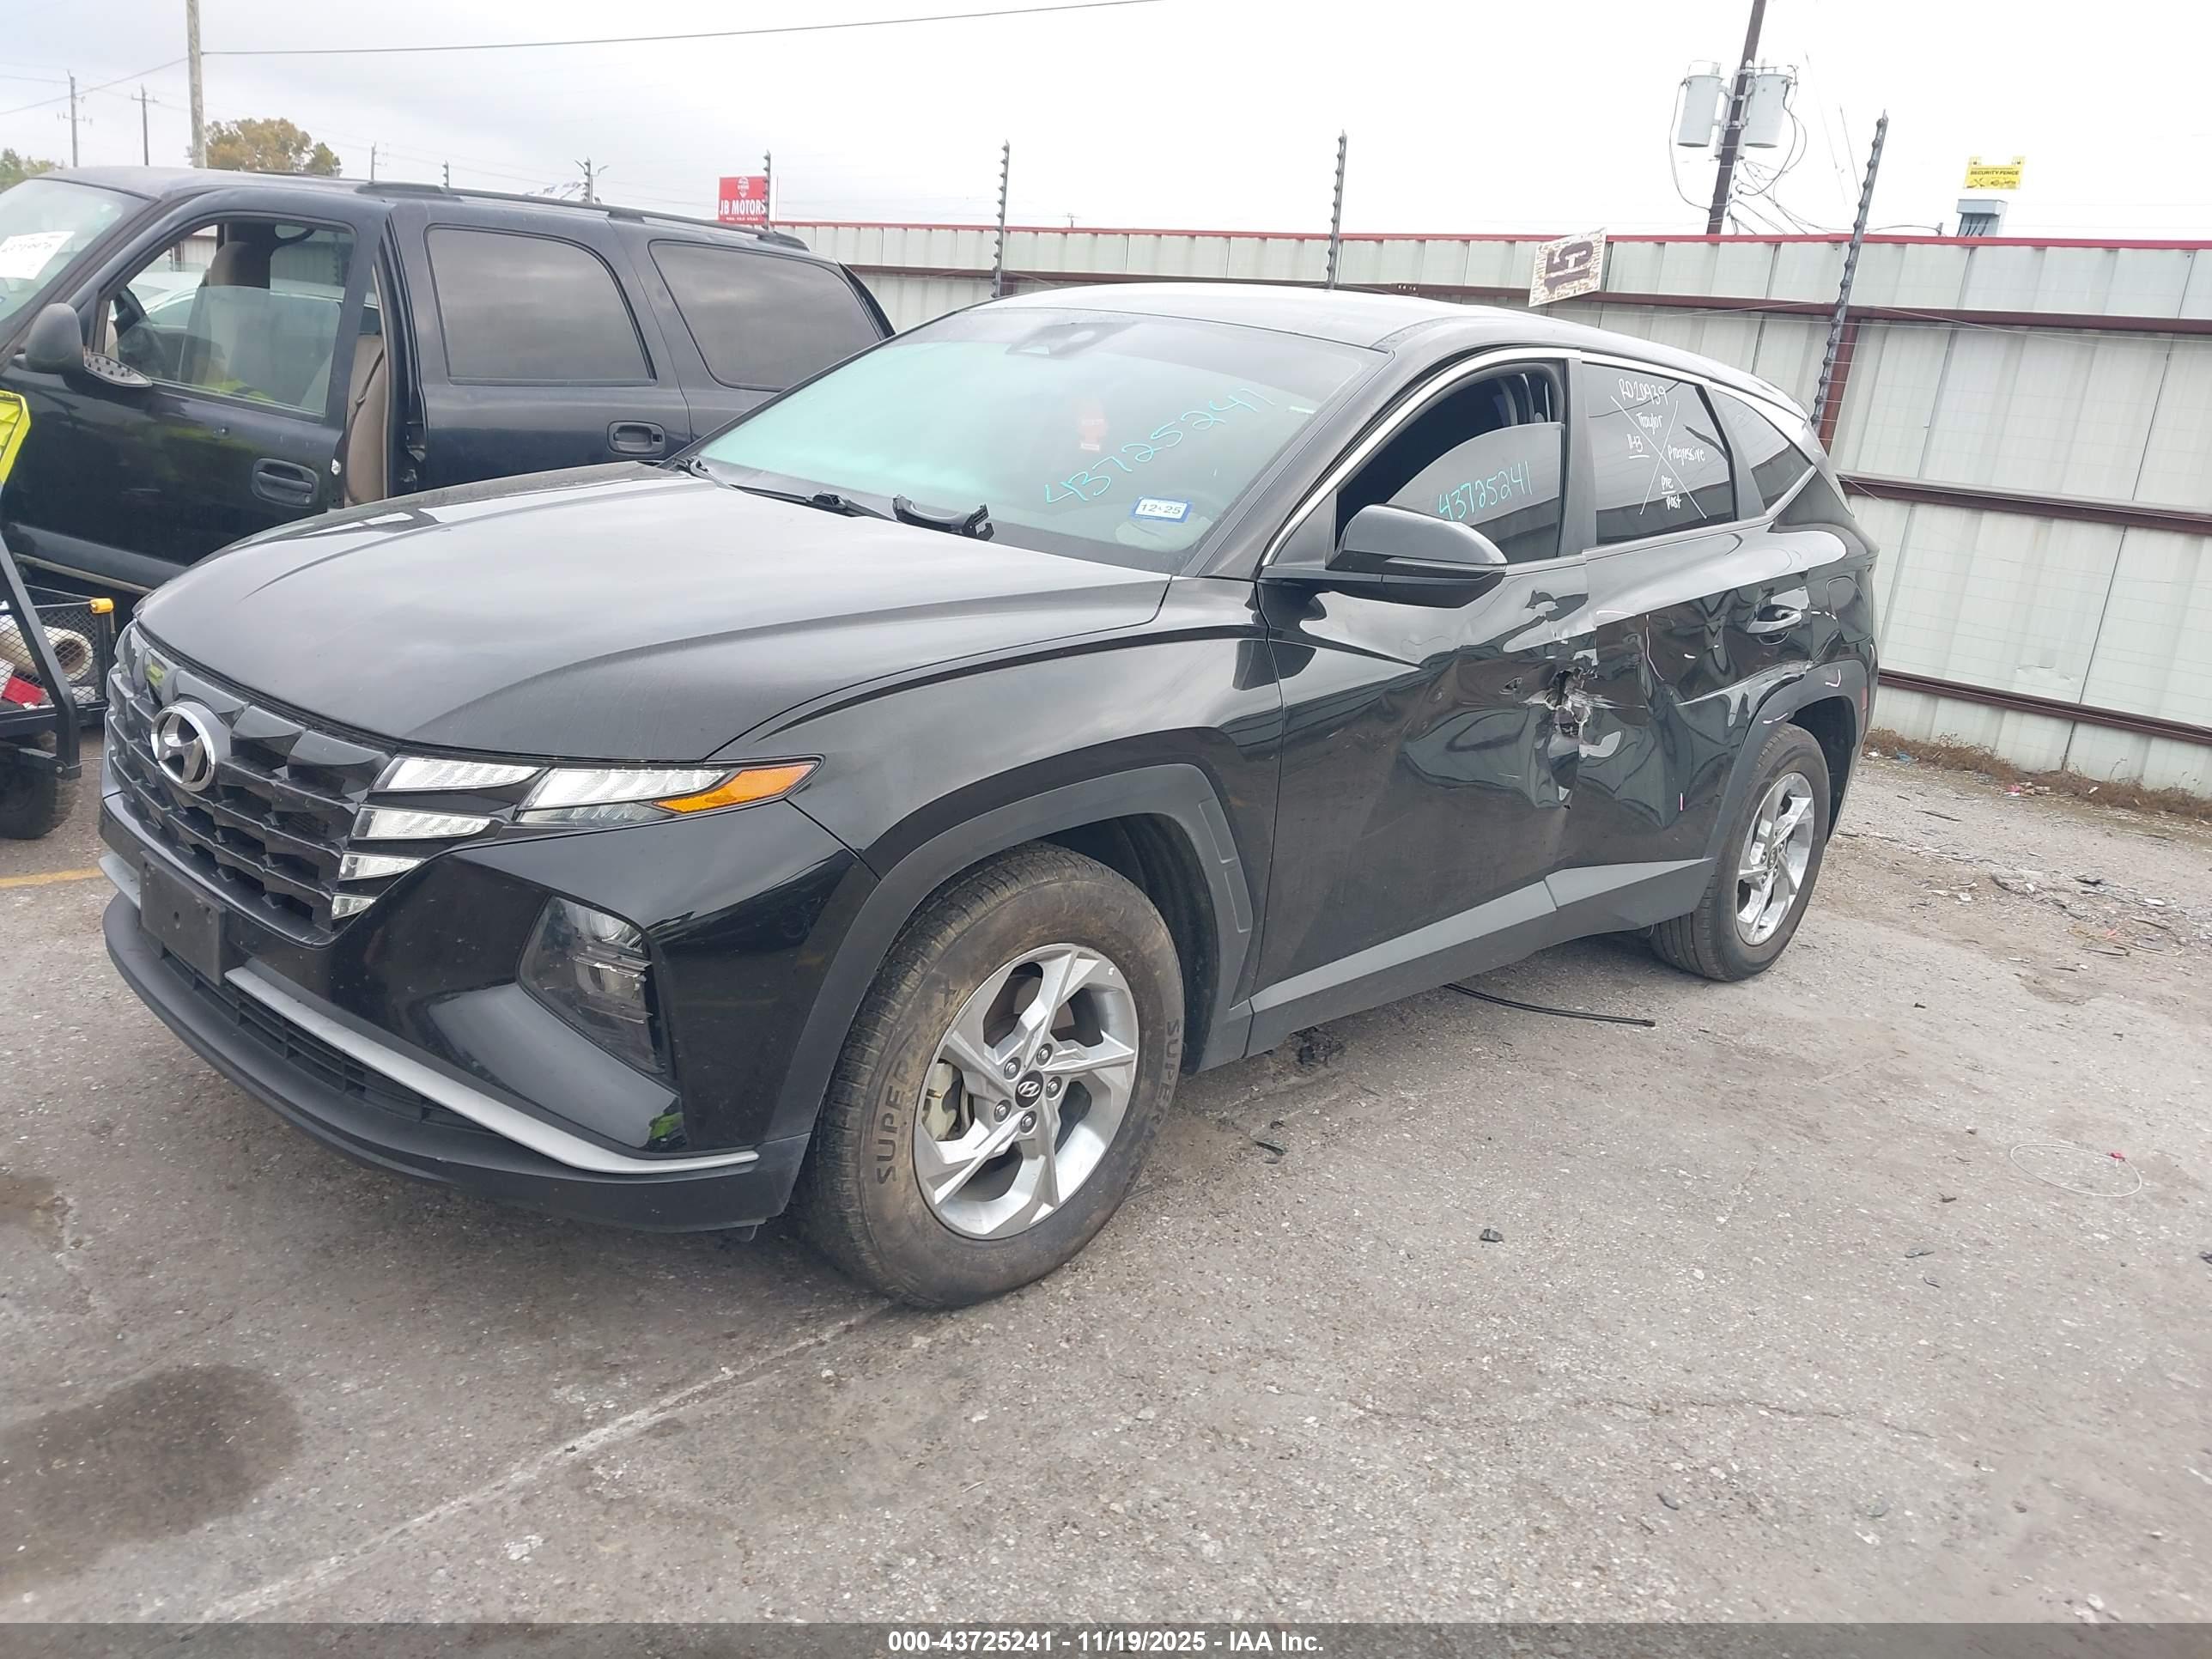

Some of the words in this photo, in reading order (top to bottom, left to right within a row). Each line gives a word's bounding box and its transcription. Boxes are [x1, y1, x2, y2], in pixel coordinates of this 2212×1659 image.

[720, 199, 730, 216] JB
[732, 198, 766, 216] MOTORS
[1044, 387, 1276, 503] 43725241
[1437, 459, 1533, 521] 43725241
